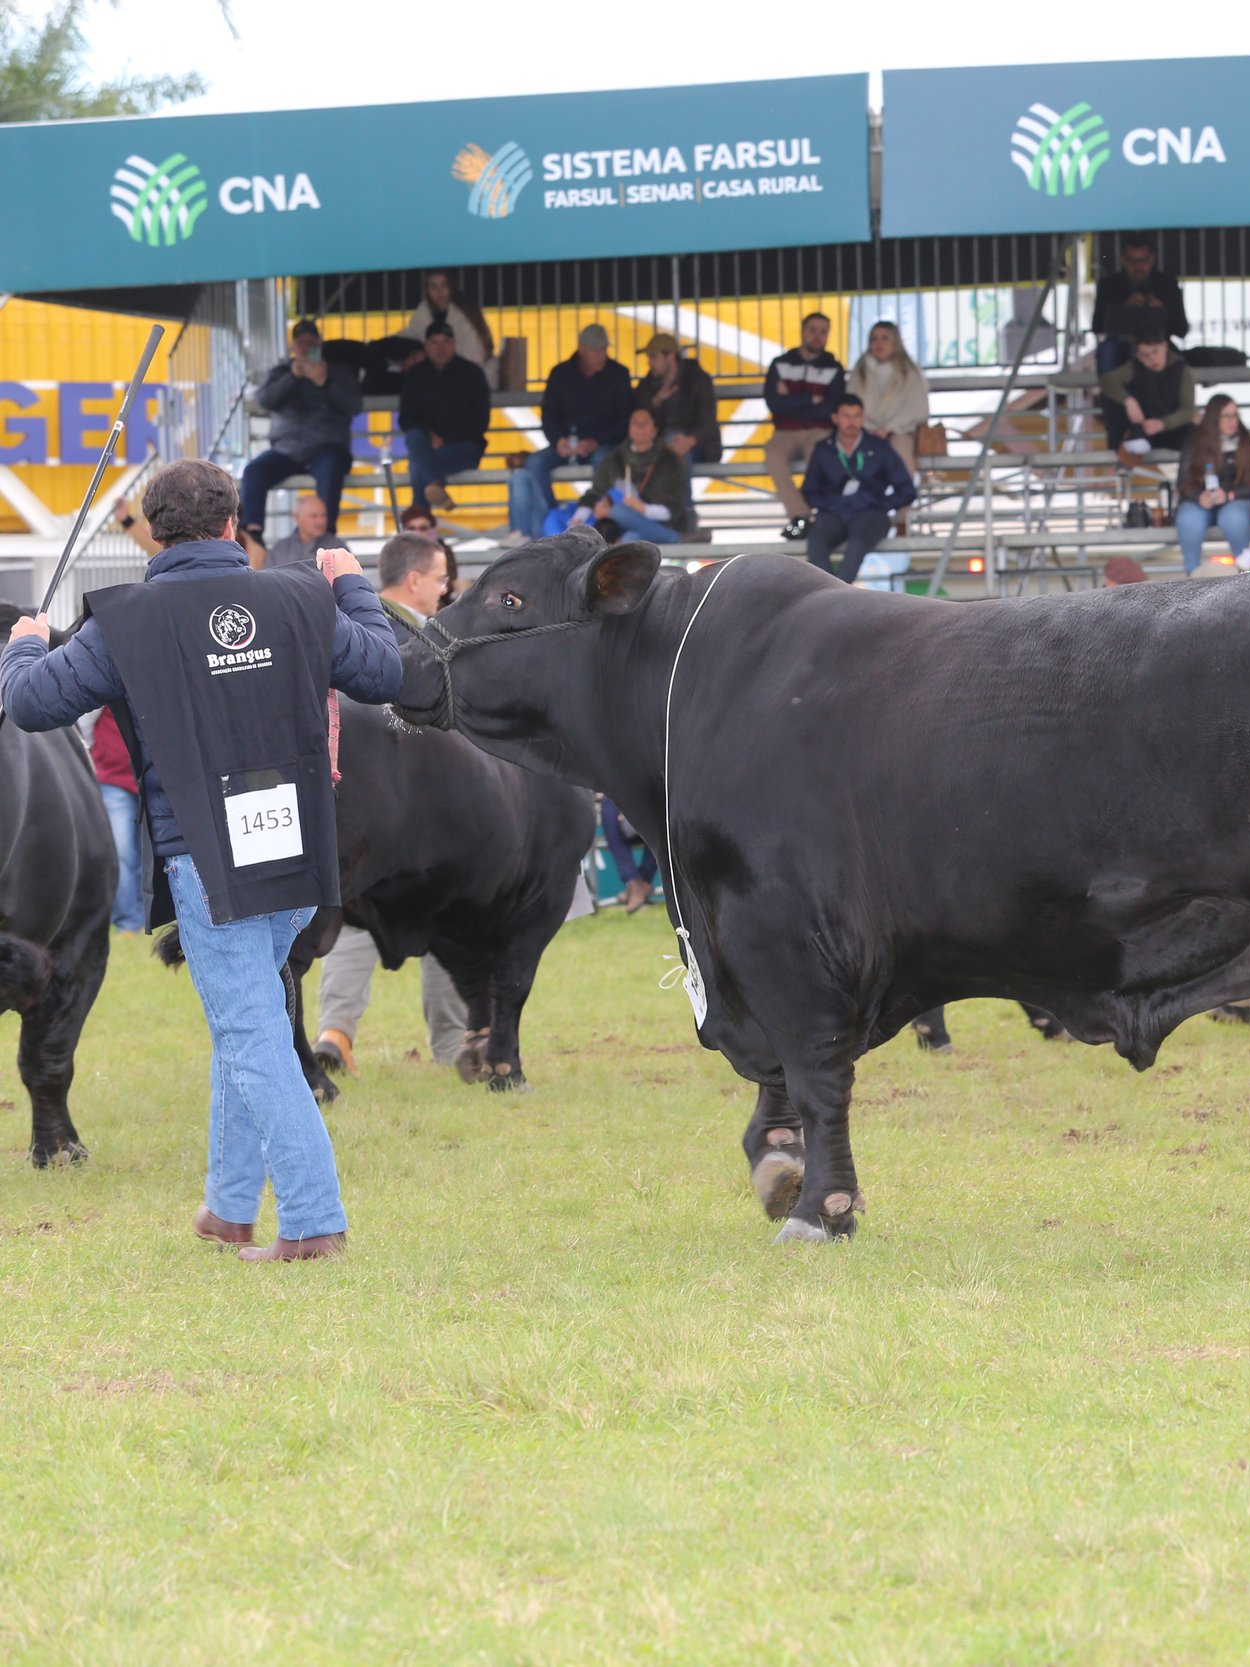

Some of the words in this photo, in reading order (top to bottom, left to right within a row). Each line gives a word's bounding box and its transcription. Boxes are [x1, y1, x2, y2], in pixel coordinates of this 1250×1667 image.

[542, 144, 687, 183] SISTEMA
[694, 137, 821, 172] FARSUL
[1122, 125, 1227, 166] CNA
[219, 173, 321, 214] CNA
[544, 187, 618, 209] FARSUL
[626, 183, 694, 204] SENAR
[702, 179, 757, 199] CASA
[758, 175, 823, 196] RURAL
[206, 648, 272, 668] Brangus
[240, 806, 293, 835] 1453
